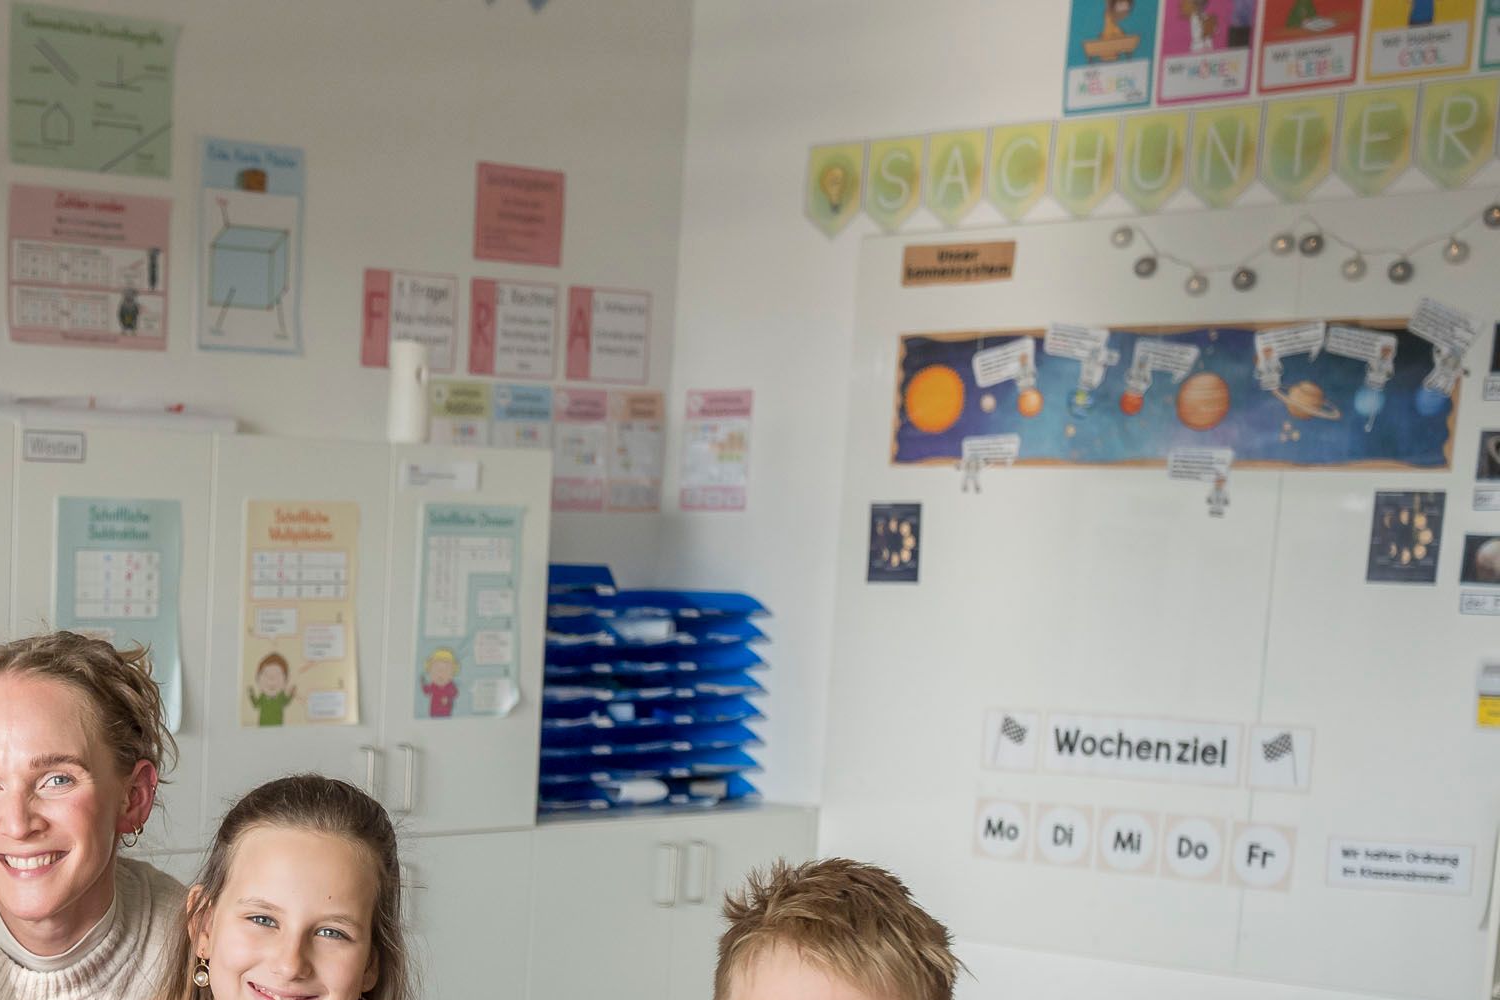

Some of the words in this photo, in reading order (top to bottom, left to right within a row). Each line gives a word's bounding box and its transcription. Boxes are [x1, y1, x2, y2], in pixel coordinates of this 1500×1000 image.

[1054, 727, 1229, 768] Wochenziel
[983, 817, 1020, 841] Mo
[1052, 823, 1074, 847] Di
[1112, 830, 1142, 854] Mi
[1176, 836, 1209, 861] Do
[1246, 843, 1276, 869] Fr
